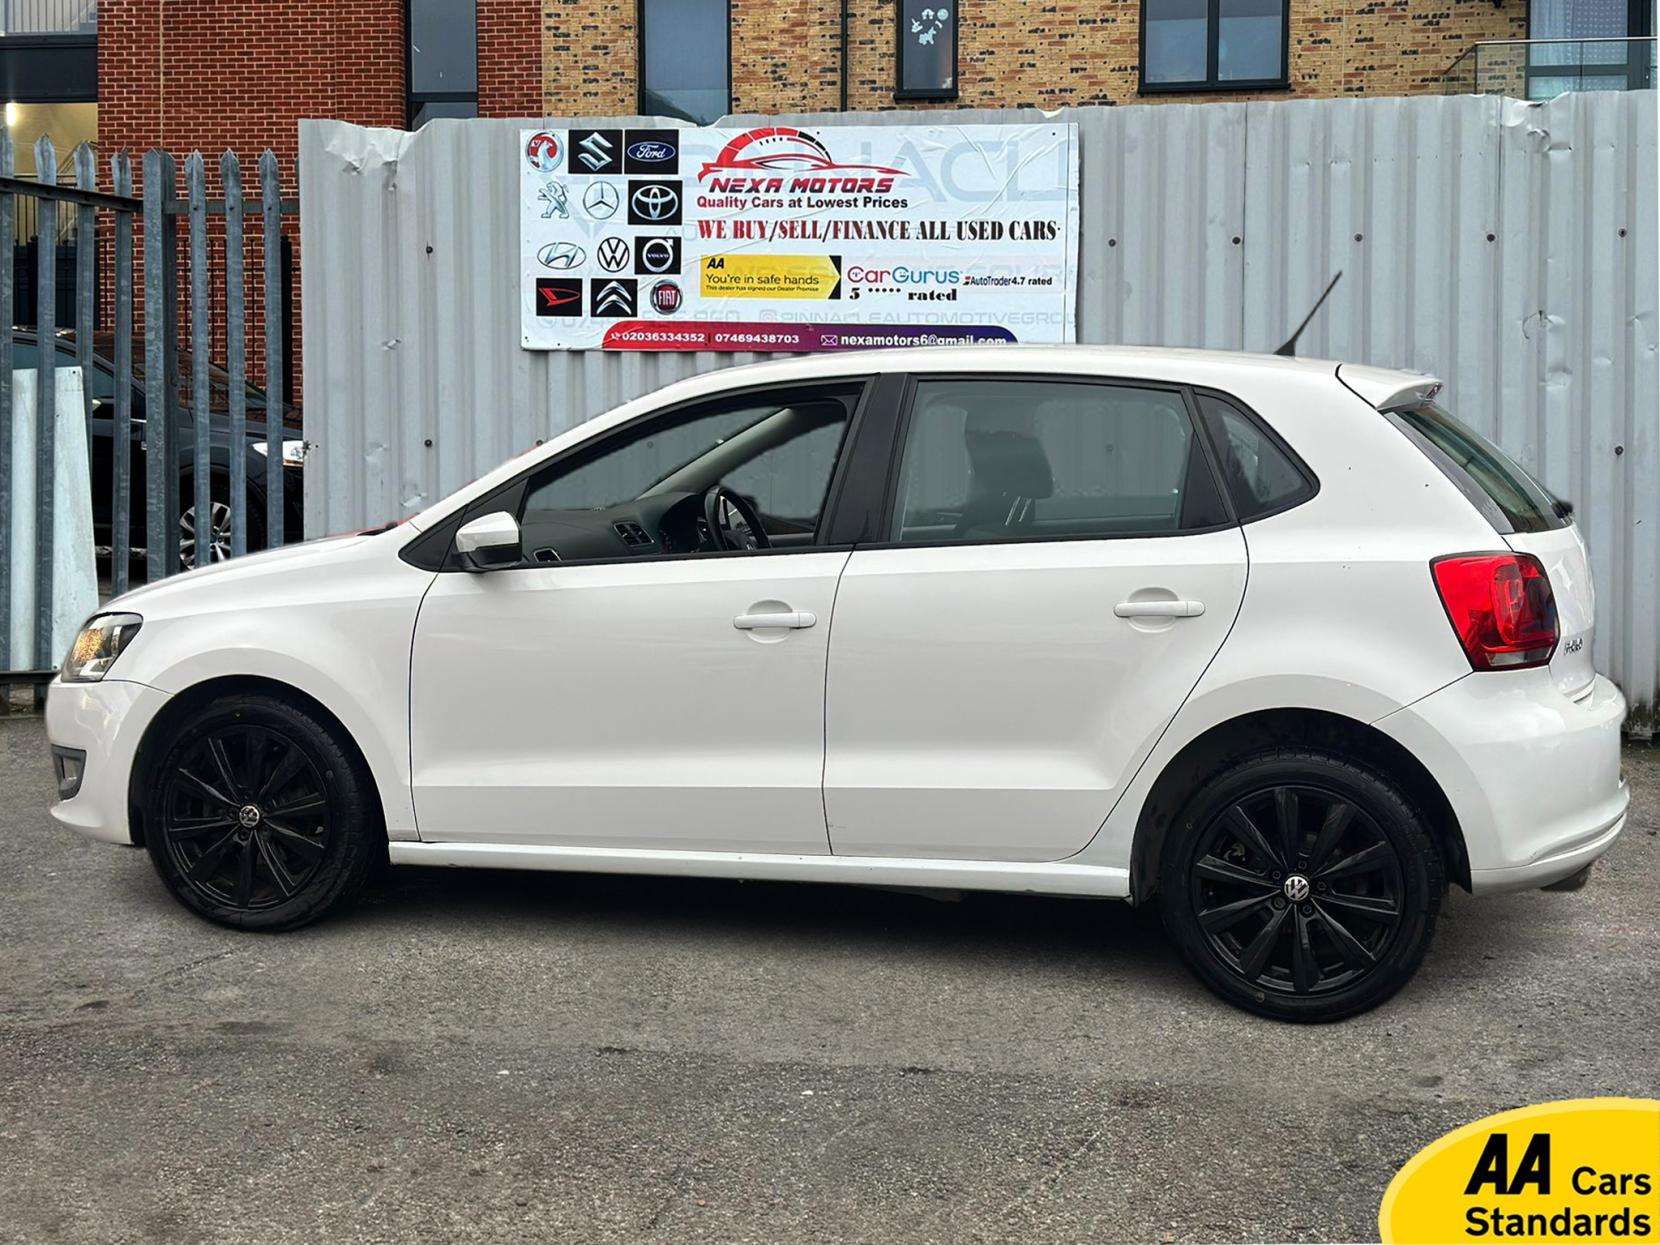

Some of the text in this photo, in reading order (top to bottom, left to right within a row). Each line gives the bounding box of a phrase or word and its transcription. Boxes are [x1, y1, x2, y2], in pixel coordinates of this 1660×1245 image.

[636, 144, 666, 159] Ford
[709, 177, 895, 193] NEXA MOTORS
[697, 196, 908, 210] Quality Cars at Lowest Prices
[698, 219, 727, 239] WE
[733, 219, 910, 243] BUY/SELL/FINANCE
[916, 220, 951, 240] ALL
[956, 220, 1004, 241] USED
[706, 257, 724, 269] AA
[706, 273, 819, 285] You're in safe hands
[847, 266, 960, 284] CarGurus
[1011, 276, 1025, 286] 4.7
[1028, 276, 1053, 286] rated
[658, 290, 676, 306] FIAT
[850, 287, 957, 301] 5 rated
[622, 332, 800, 344] 02036334352 07469438703
